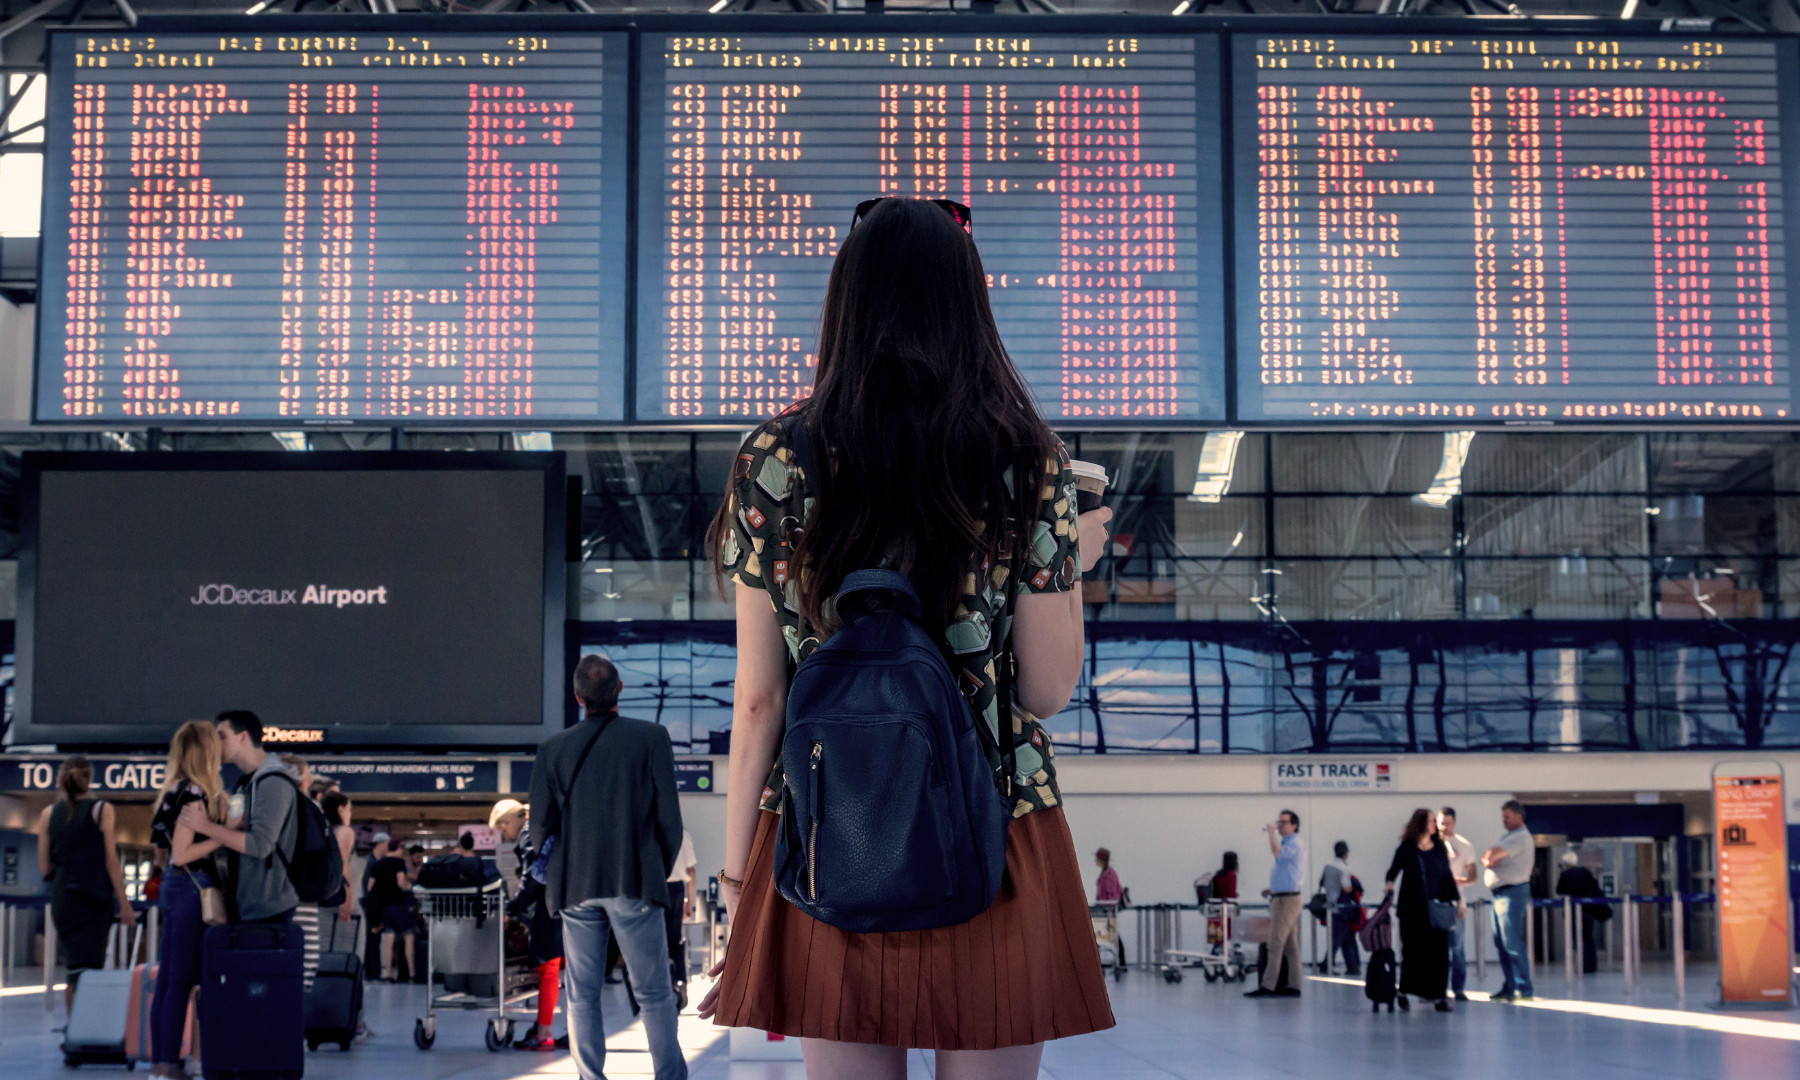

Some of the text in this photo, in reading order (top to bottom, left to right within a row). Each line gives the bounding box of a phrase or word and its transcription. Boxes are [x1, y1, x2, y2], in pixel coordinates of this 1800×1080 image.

[190, 584, 388, 609] JCDecaux Airport
[18, 763, 53, 789] TO
[317, 764, 337, 774] YOUR
[338, 764, 375, 774] PASSPORT
[376, 764, 391, 774] AND
[393, 764, 430, 774] BOARDING
[431, 764, 448, 774] PASS
[450, 764, 475, 774] READY
[1278, 764, 1368, 777] FAST TRACK
